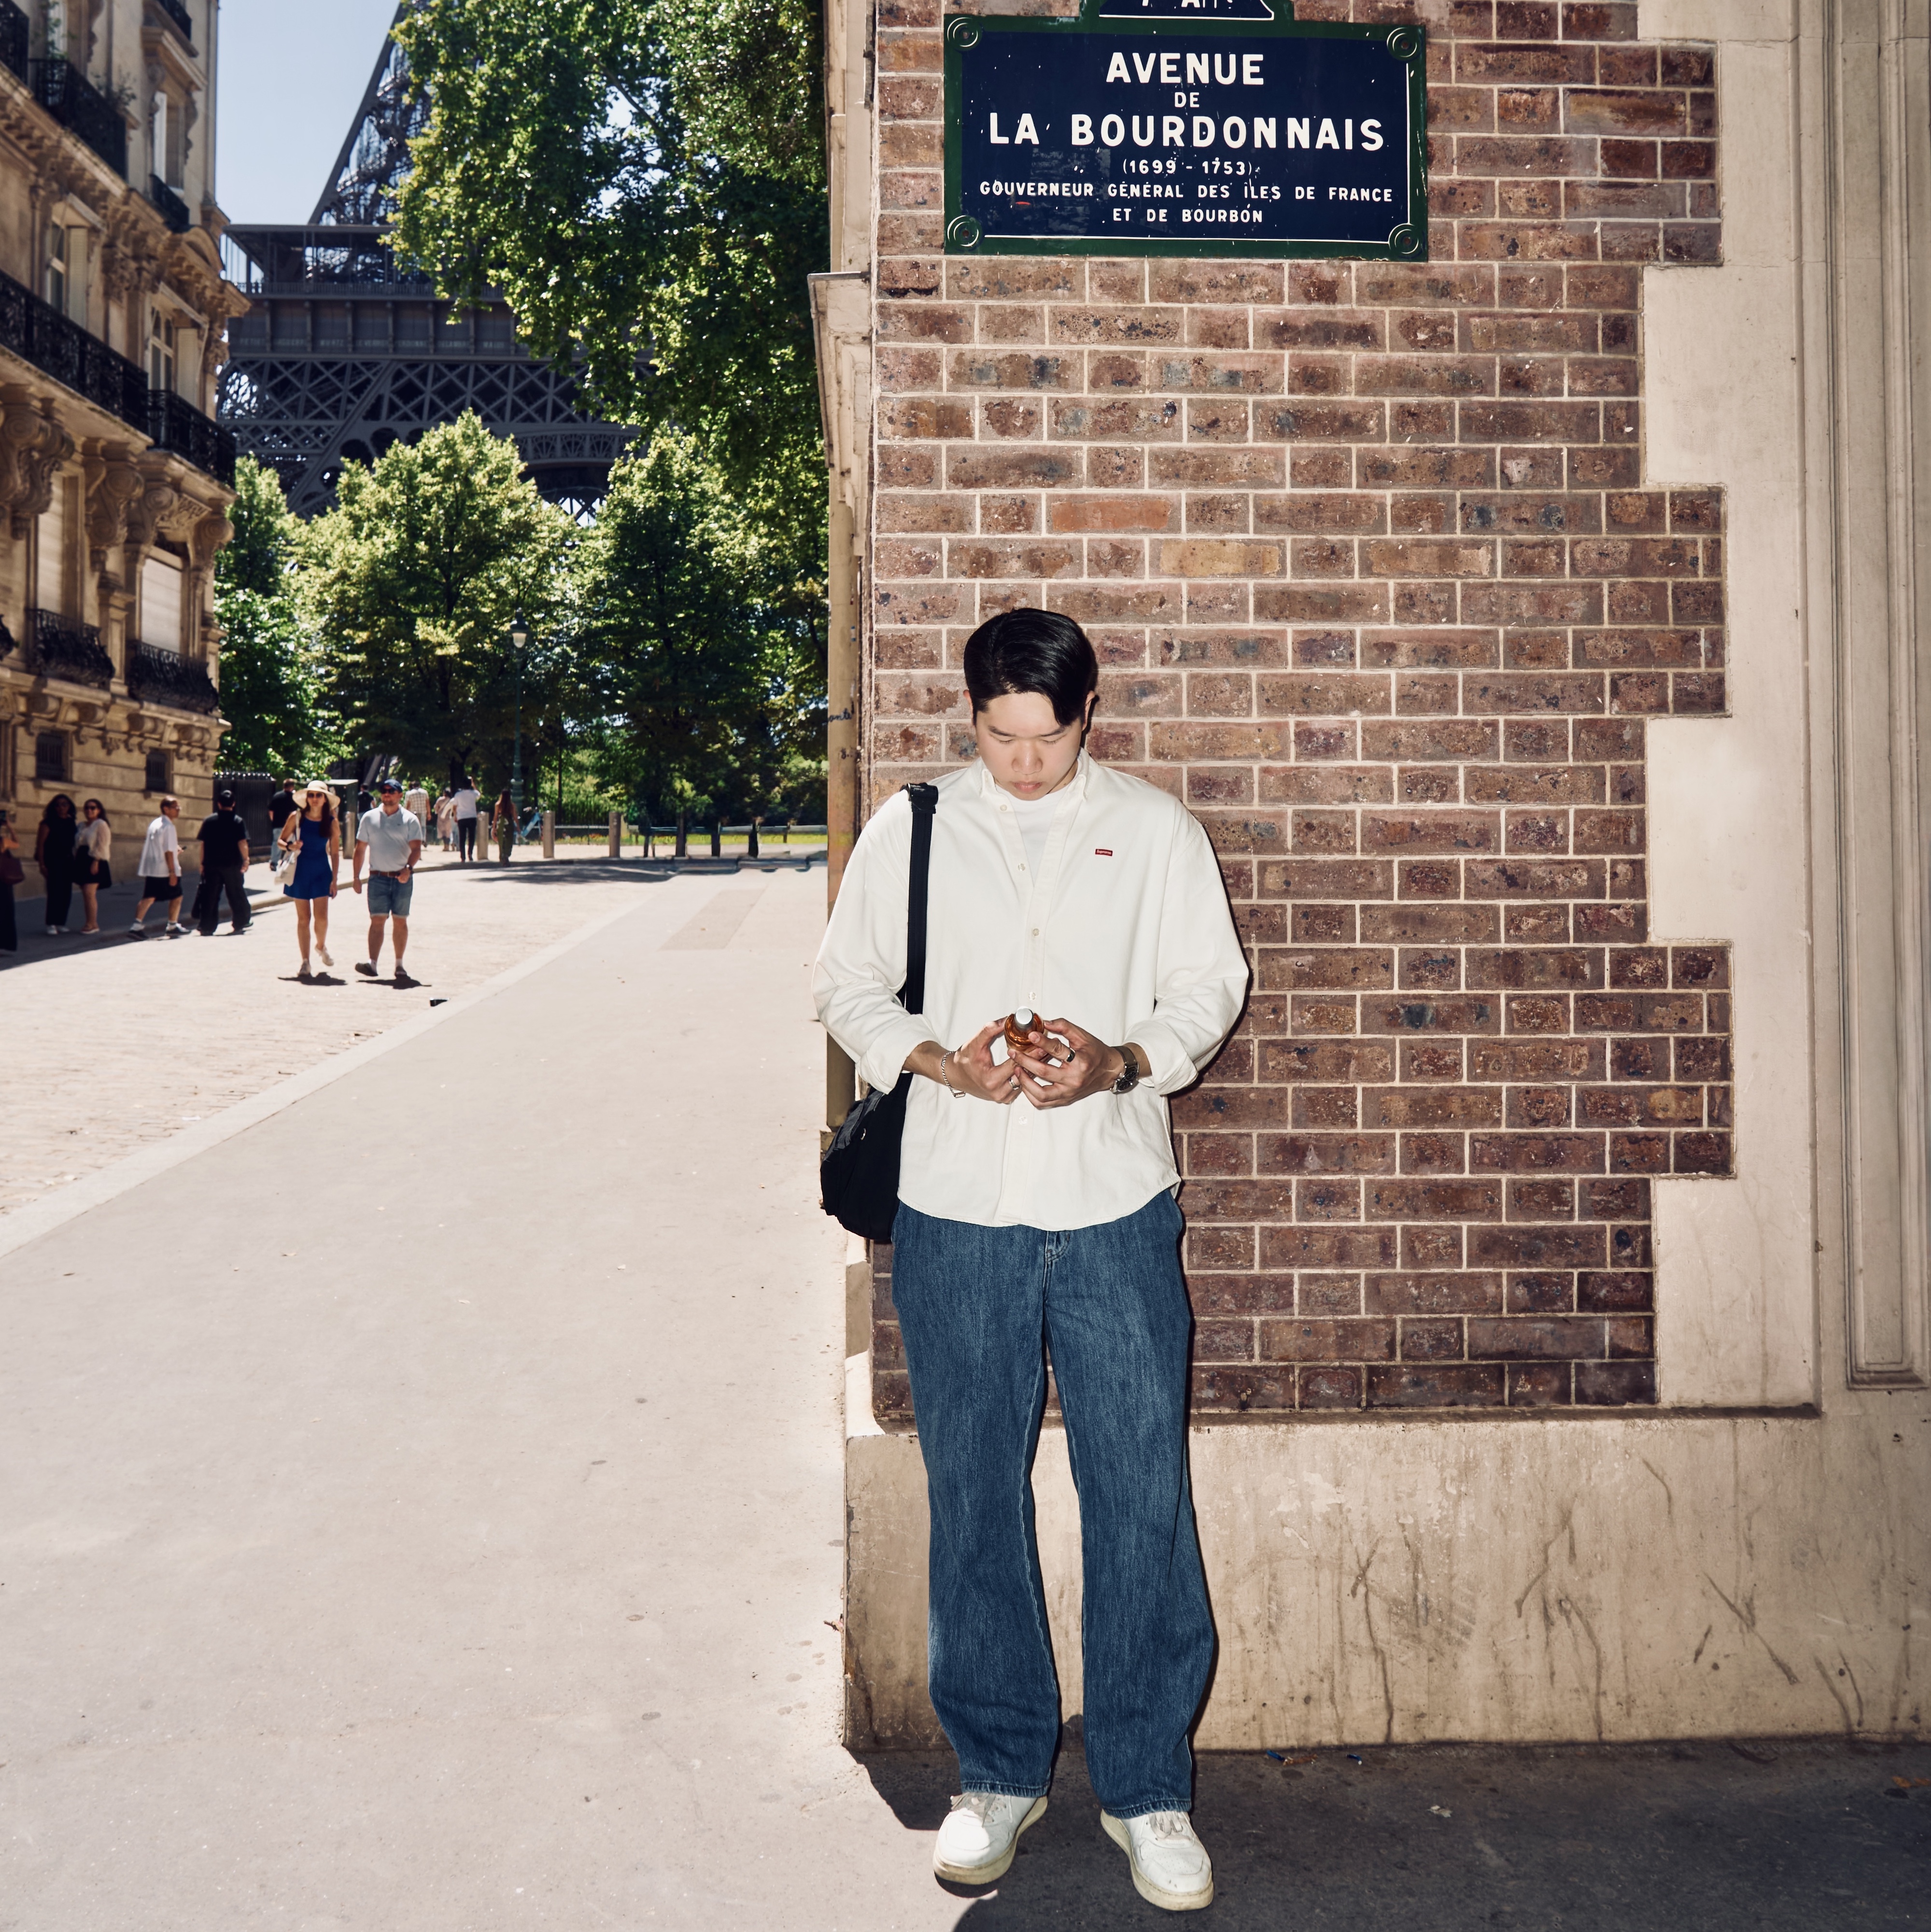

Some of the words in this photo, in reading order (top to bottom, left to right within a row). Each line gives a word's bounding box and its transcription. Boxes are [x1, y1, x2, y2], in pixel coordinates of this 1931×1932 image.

[1106, 52, 1264, 85] AVENUE
[1174, 92, 1199, 108] DE
[990, 112, 1040, 145] LA
[1071, 113, 1383, 151] BOURDONNAIS
[1123, 157, 1177, 174] (1699
[1202, 157, 1252, 175] 1753)
[980, 179, 1094, 197] GOUVERNEUR
[1108, 182, 1184, 199] GÉNÉRAL
[1198, 185, 1230, 198] DES
[1295, 186, 1315, 199] DE
[1329, 187, 1392, 202] FRANCE
[1113, 208, 1132, 221] ET
[1147, 209, 1168, 222] DE
[1182, 209, 1262, 223] BOURBON
